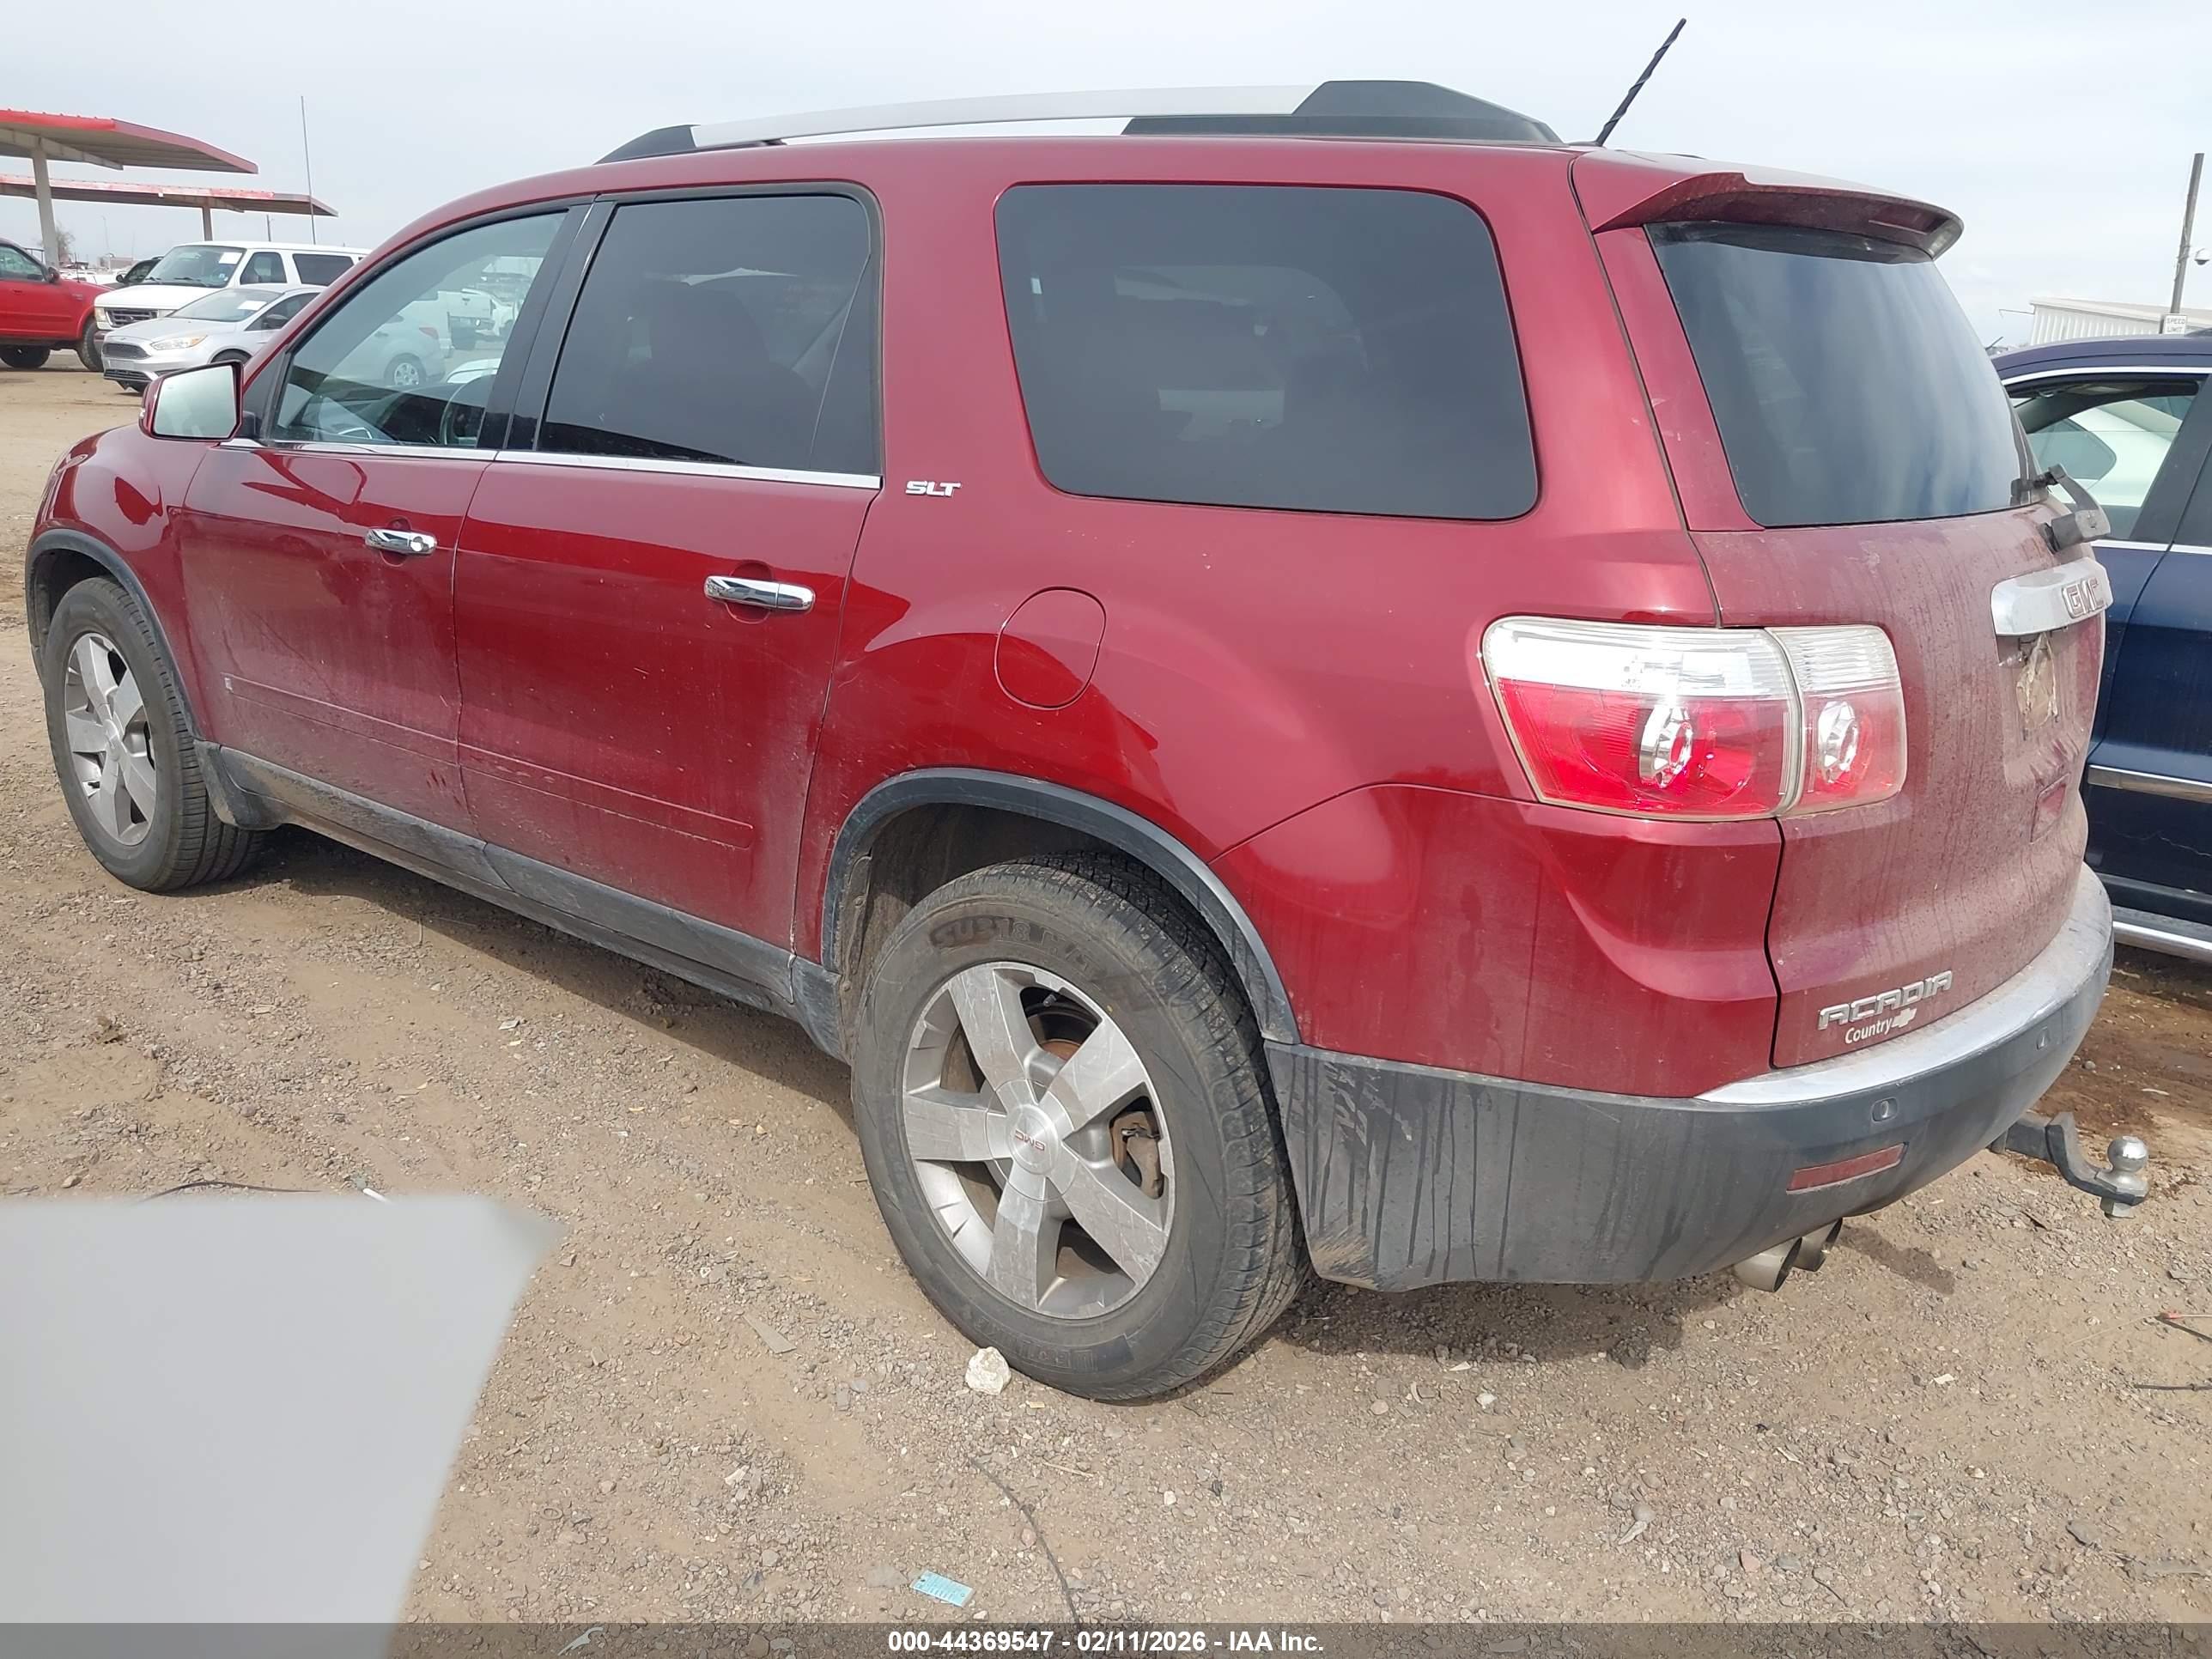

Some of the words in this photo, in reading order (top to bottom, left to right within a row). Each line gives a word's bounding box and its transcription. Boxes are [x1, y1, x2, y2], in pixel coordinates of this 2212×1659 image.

[905, 480, 962, 497] SLT
[2062, 577, 2105, 619] GMC
[1818, 970, 1953, 1030] ACADIA
[1845, 1017, 1893, 1044] Country
[1015, 1128, 1046, 1152] GMC
